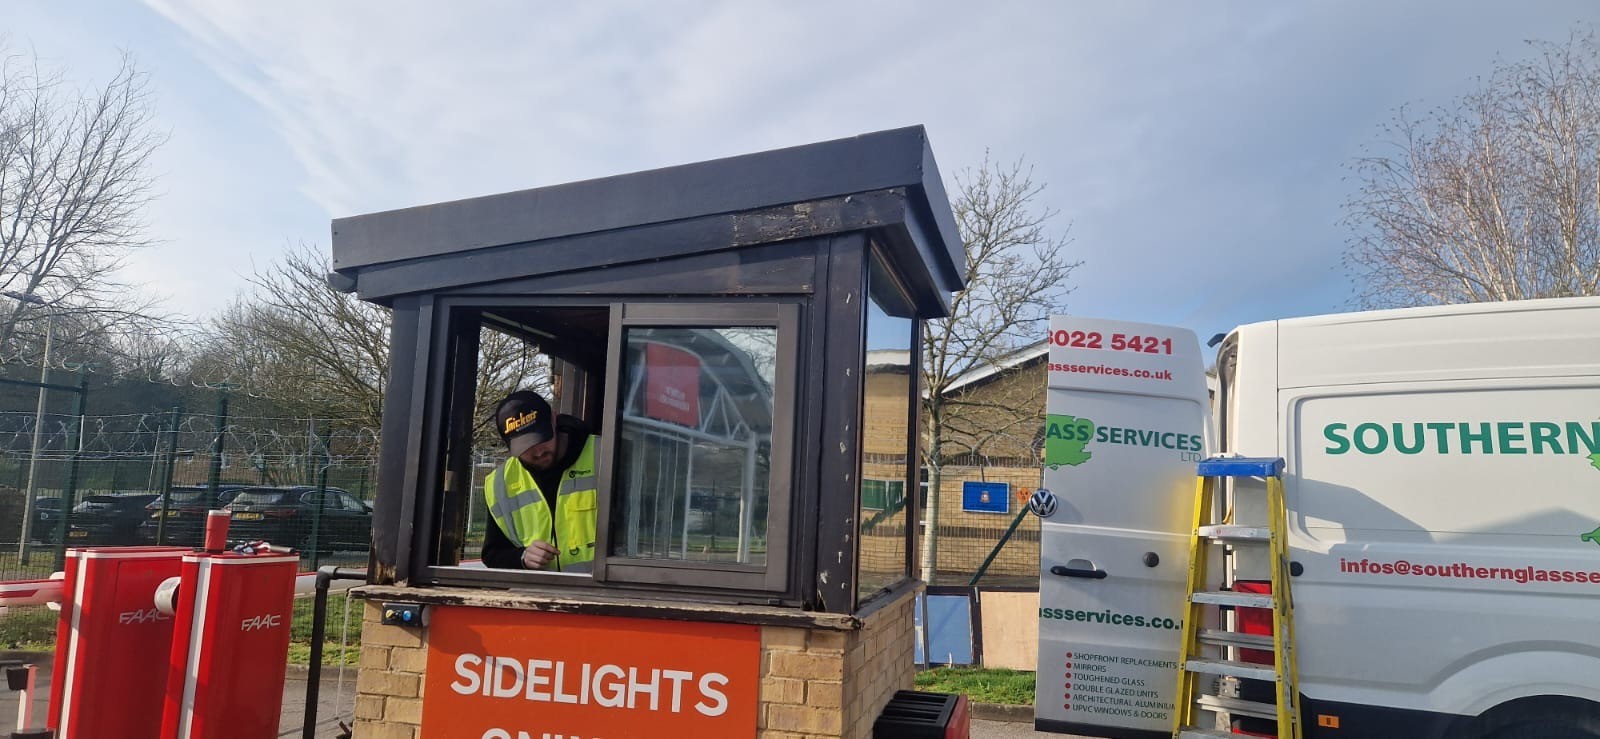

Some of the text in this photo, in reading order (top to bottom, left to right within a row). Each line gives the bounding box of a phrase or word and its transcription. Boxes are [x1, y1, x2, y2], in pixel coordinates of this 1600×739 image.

[1111, 333, 1172, 355] 5421
[1048, 362, 1172, 380] assservices.co.uk
[1046, 423, 1202, 451] ASS SERVICES
[1323, 421, 1600, 455] SOUTHERN
[1181, 451, 1202, 462] LTD
[1340, 558, 1600, 584] infos@southernglassse
[241, 614, 281, 632] FAAC
[1039, 607, 1184, 630] ssservices.co.
[1073, 652, 1177, 670] SHOPFRONT REPLACEMENTS
[1073, 663, 1107, 673] MIRRORS
[451, 653, 729, 717] SIDELIGHTS
[1073, 673, 1145, 687] TOUGHENED GLASS
[1072, 693, 1132, 707] ARCHITECTURAL
[1073, 683, 1159, 699] DOUBLE GLAZED UNITS
[1072, 704, 1093, 713] UPVC
[1093, 706, 1132, 718] WINDOWS
[1140, 711, 1168, 721] DOORS
